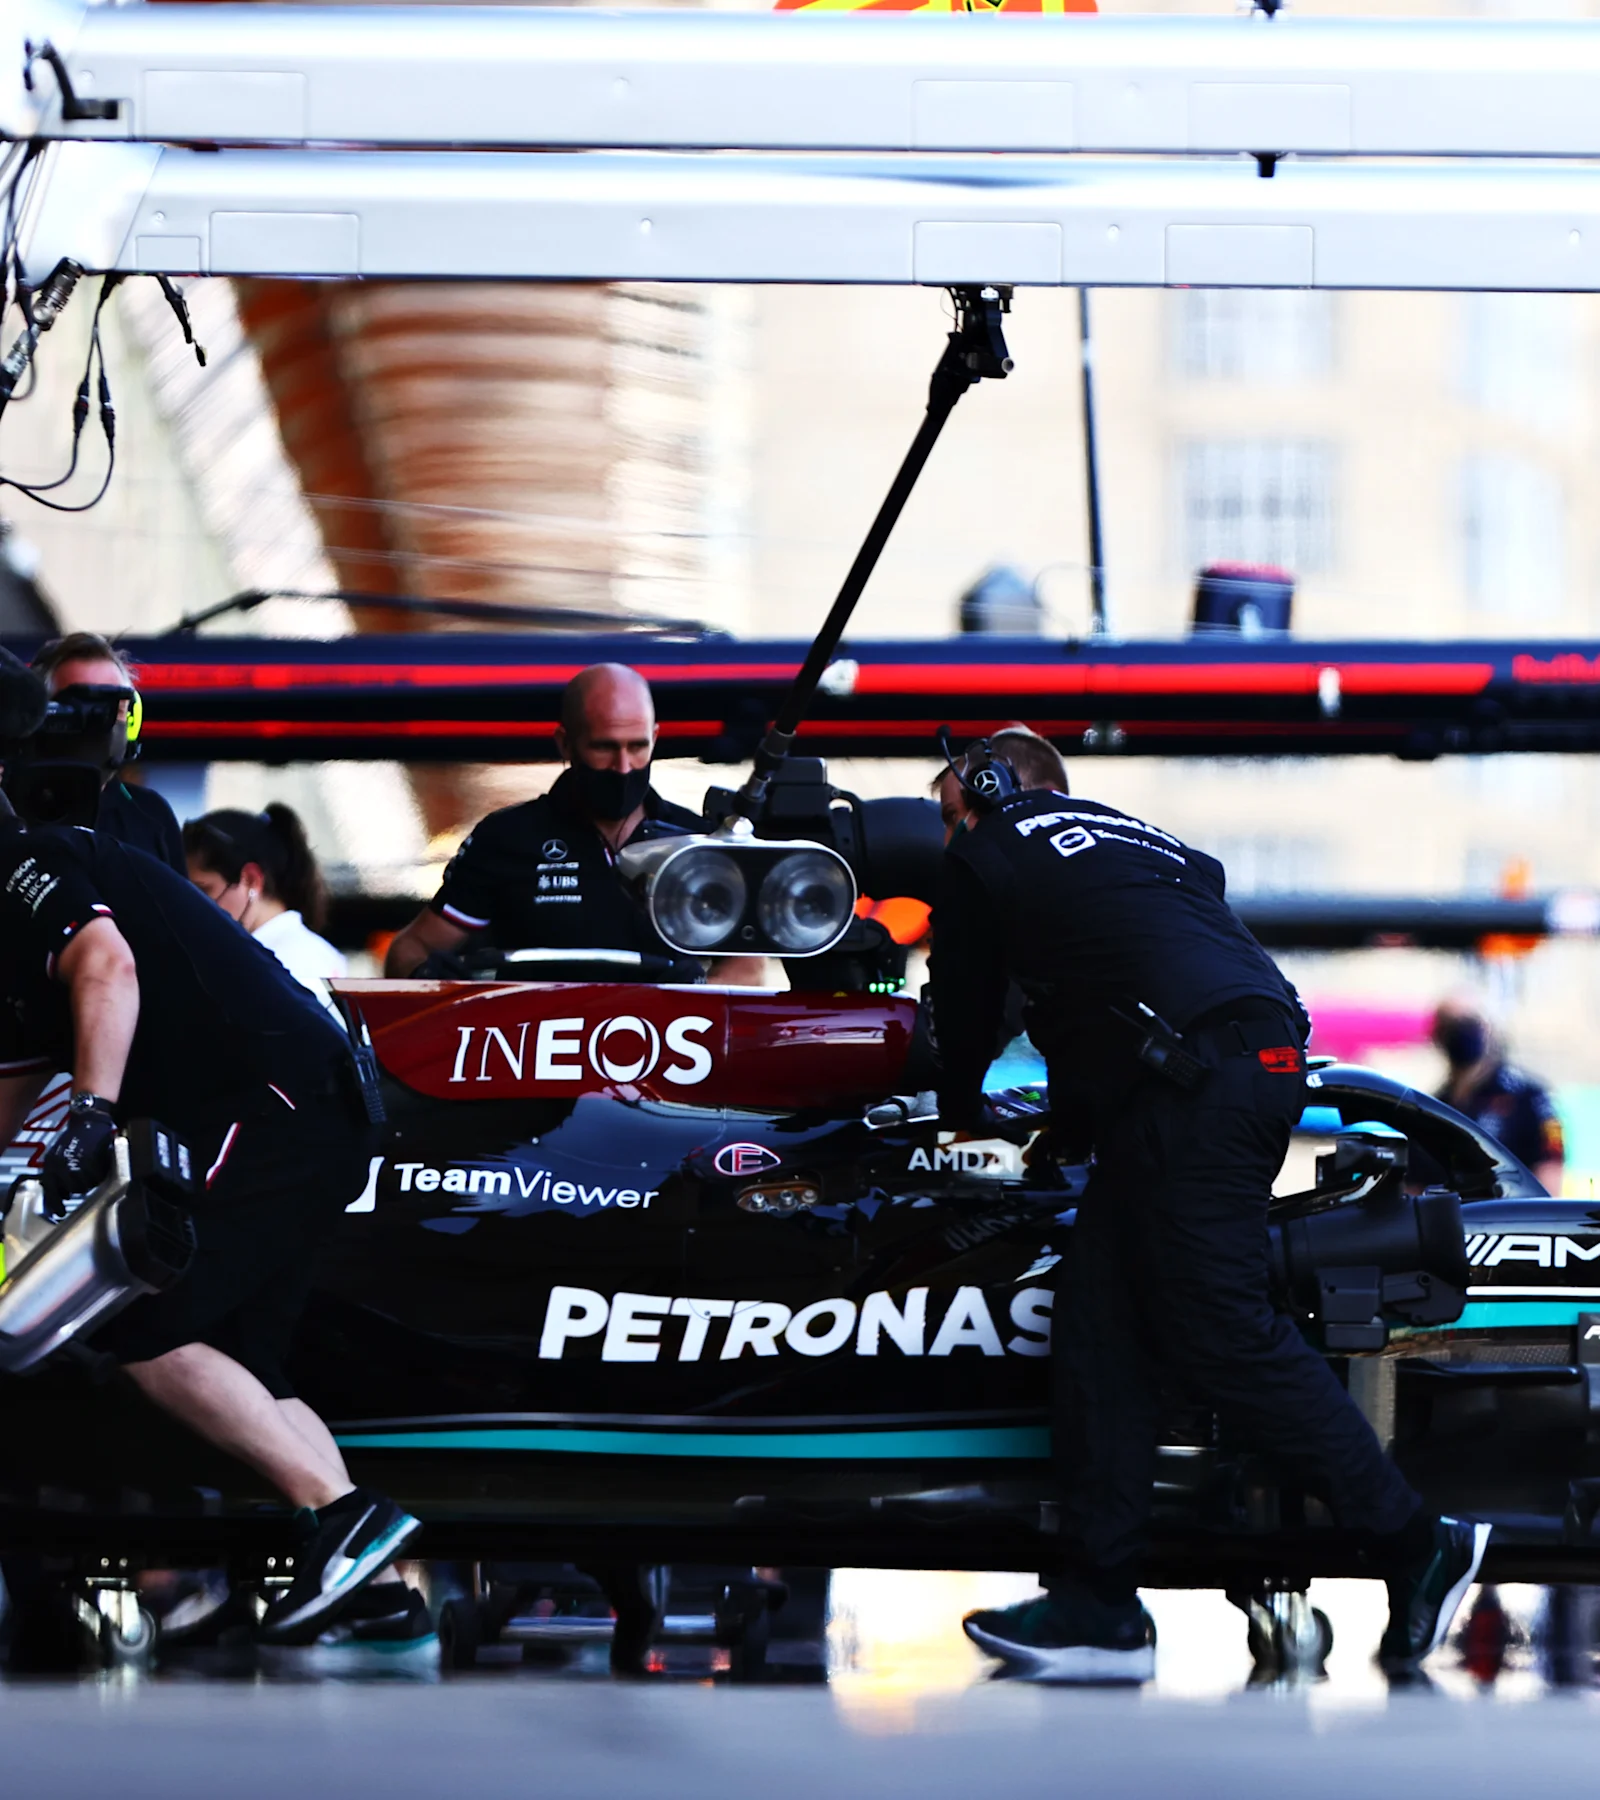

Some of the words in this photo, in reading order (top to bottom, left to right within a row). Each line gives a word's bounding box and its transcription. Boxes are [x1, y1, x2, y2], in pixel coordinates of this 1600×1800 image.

[17, 870, 38, 893] IWC
[552, 875, 579, 888] UBS
[449, 1015, 714, 1085] INEOS
[908, 1147, 984, 1171] AMD
[394, 1162, 659, 1209] TeamViewer
[538, 1285, 1055, 1362] PETRONAS
